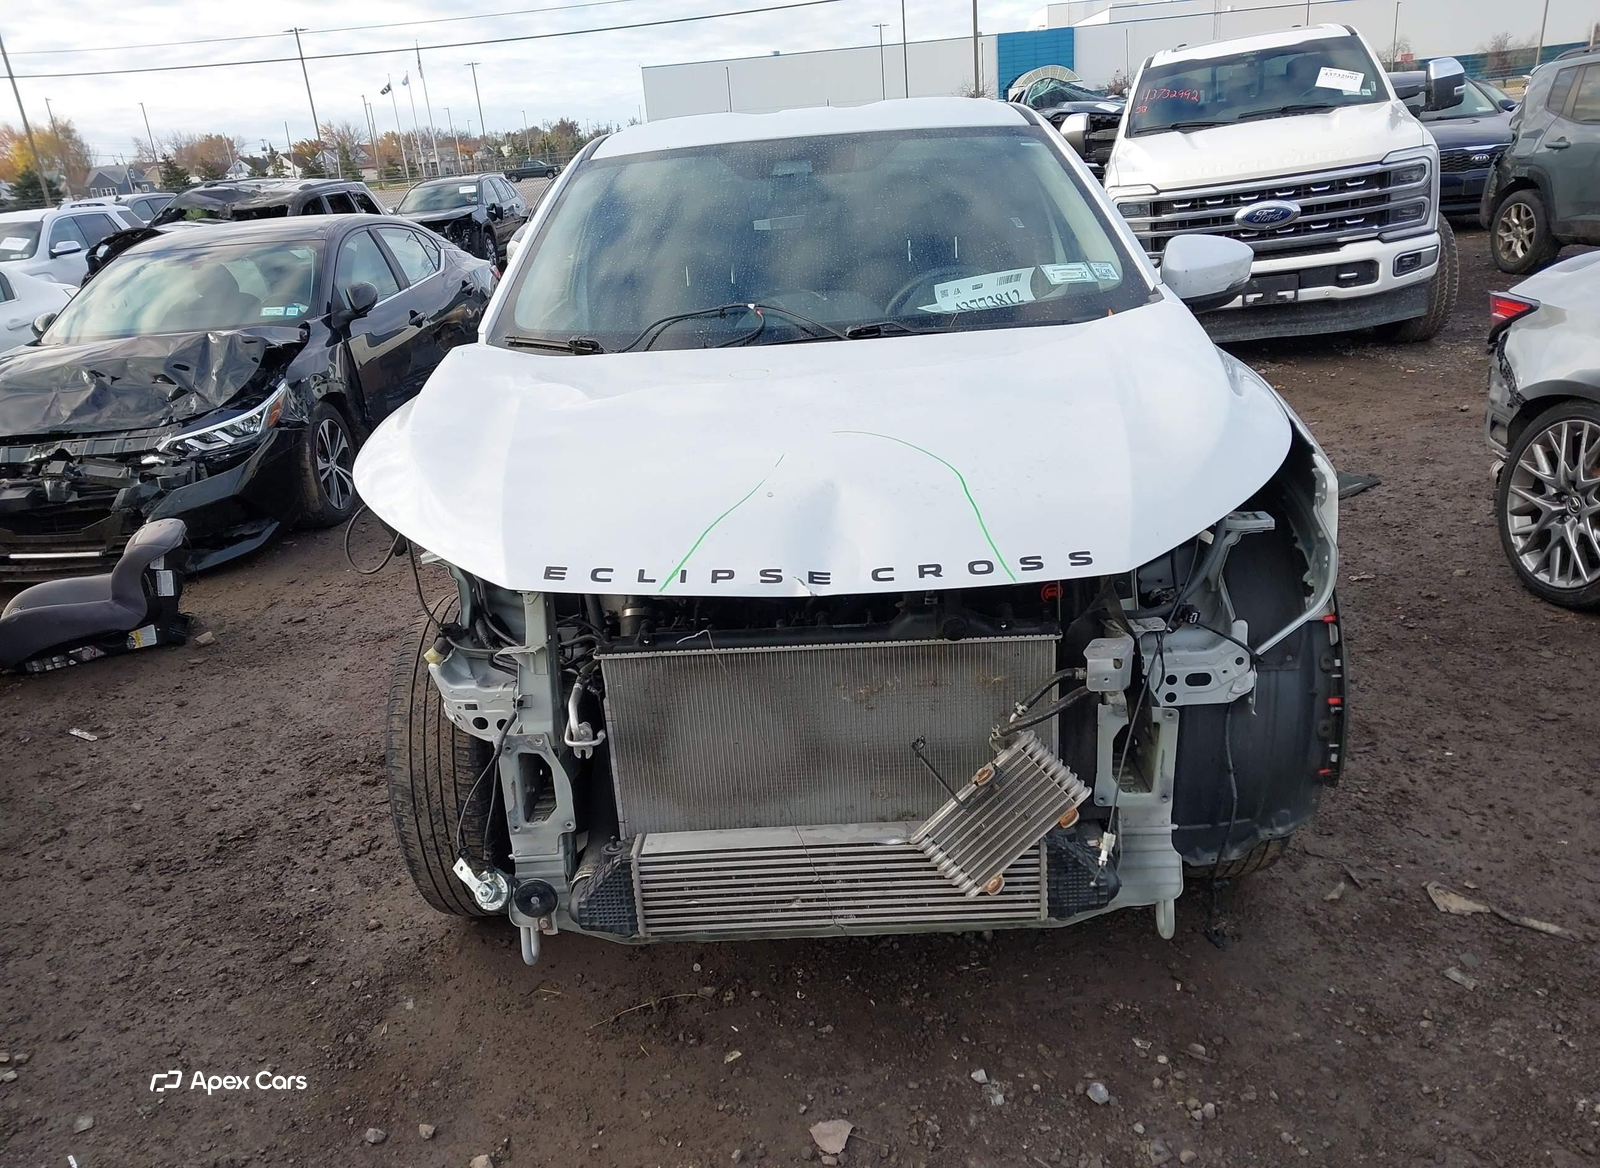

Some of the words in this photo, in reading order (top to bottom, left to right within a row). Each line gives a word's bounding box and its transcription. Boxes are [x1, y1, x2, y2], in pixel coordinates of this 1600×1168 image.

[1141, 88, 1198, 102] 43732992
[1253, 208, 1284, 222] Ford
[543, 565, 831, 585] ECLIPSE
[871, 550, 1093, 582] CROSS
